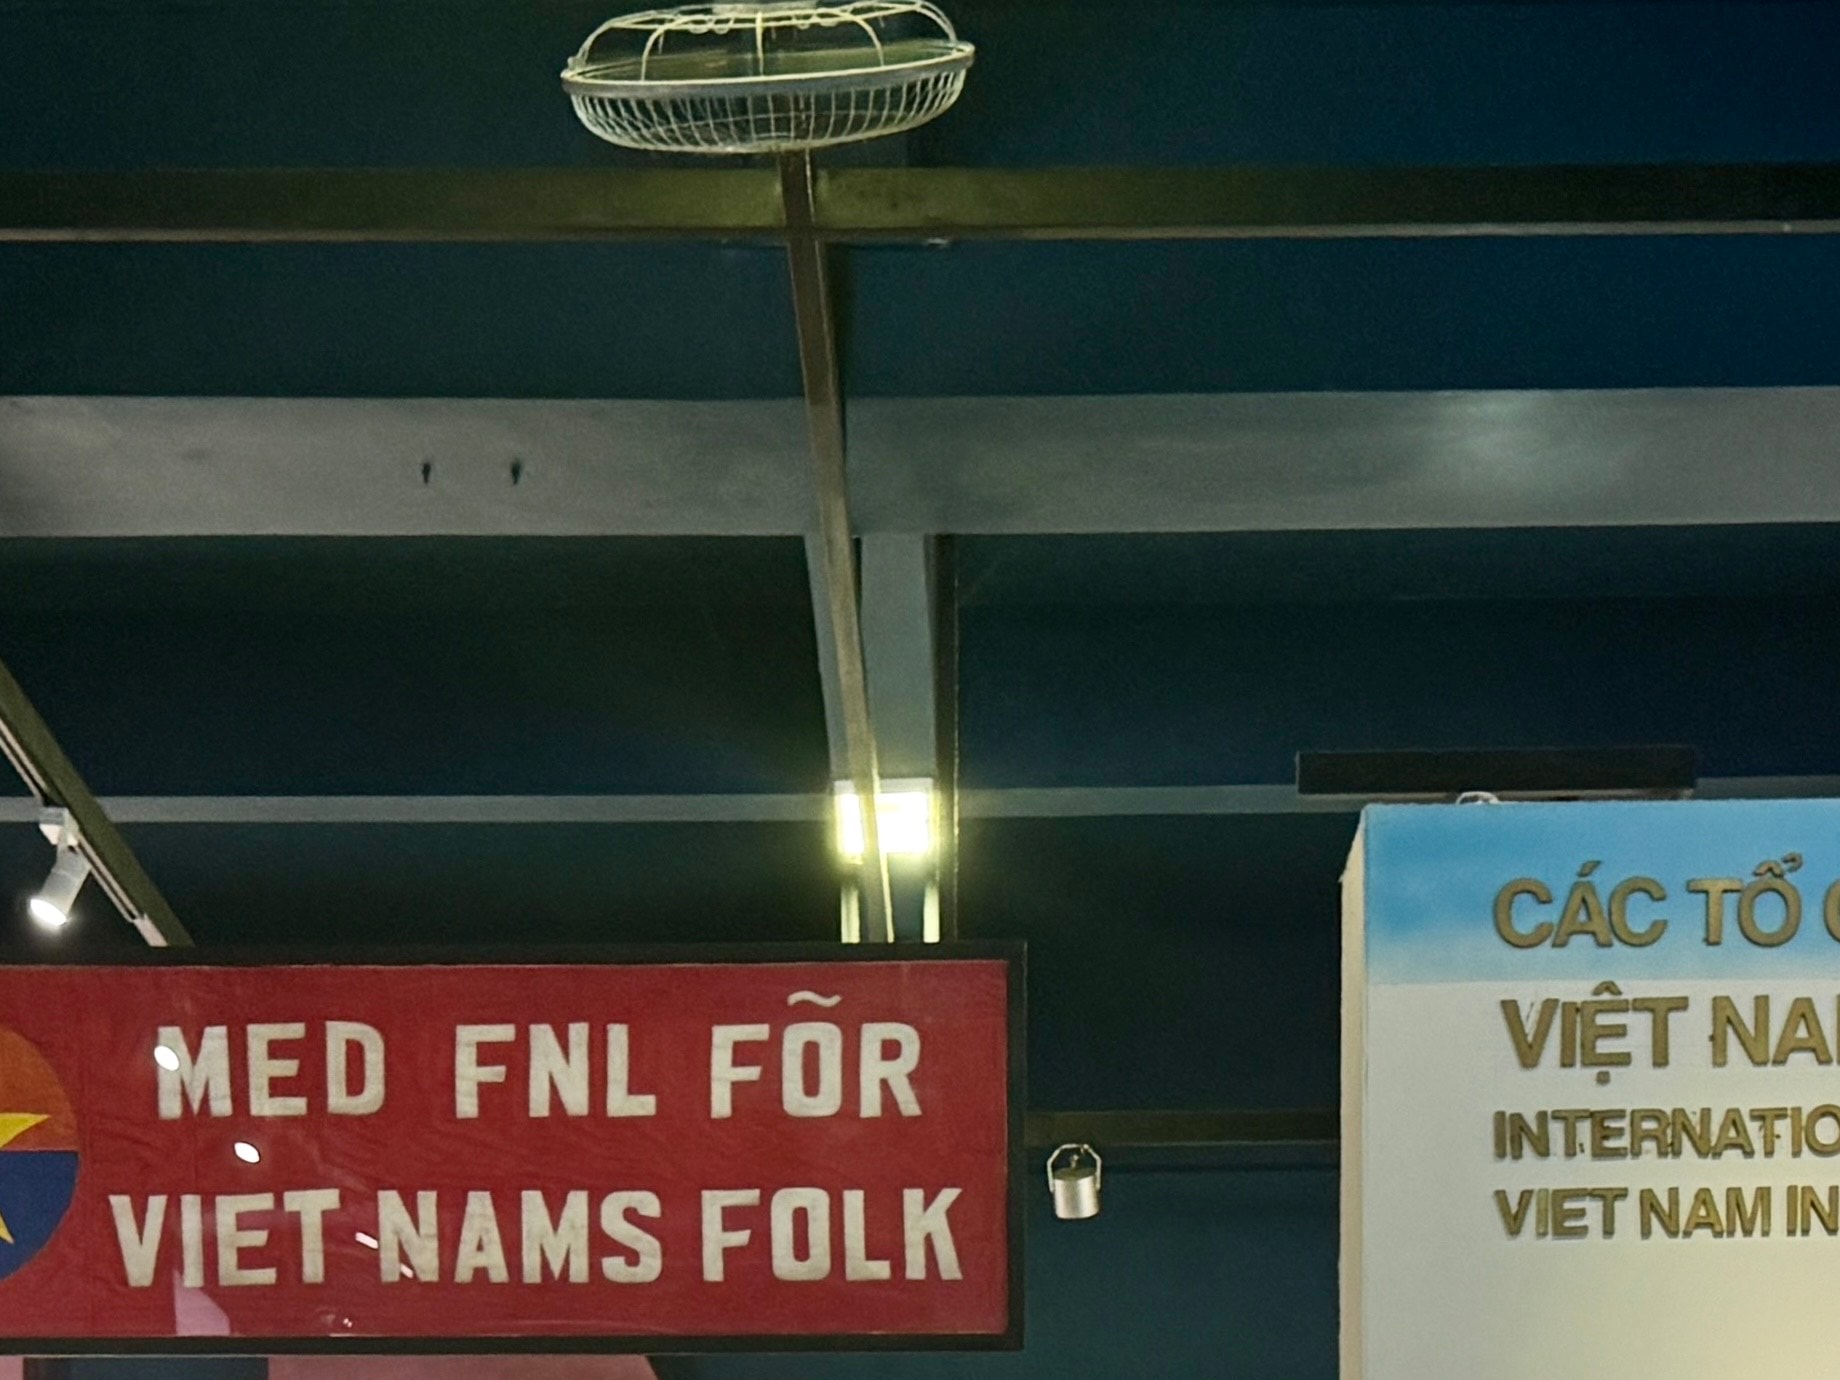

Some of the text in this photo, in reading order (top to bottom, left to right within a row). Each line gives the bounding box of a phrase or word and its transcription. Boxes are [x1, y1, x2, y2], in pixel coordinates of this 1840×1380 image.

[1493, 860, 1668, 949] CÁC
[1686, 853, 1803, 947] TỔ
[158, 1023, 385, 1121] MED
[454, 1022, 656, 1119] FNL
[1500, 980, 1690, 1085] VIỆT
[108, 1185, 964, 1289] VIET NAMS FOLK
[1494, 1187, 1629, 1238] VIET
[1639, 1185, 1772, 1238] NAM
[1786, 1185, 1840, 1236] IN
